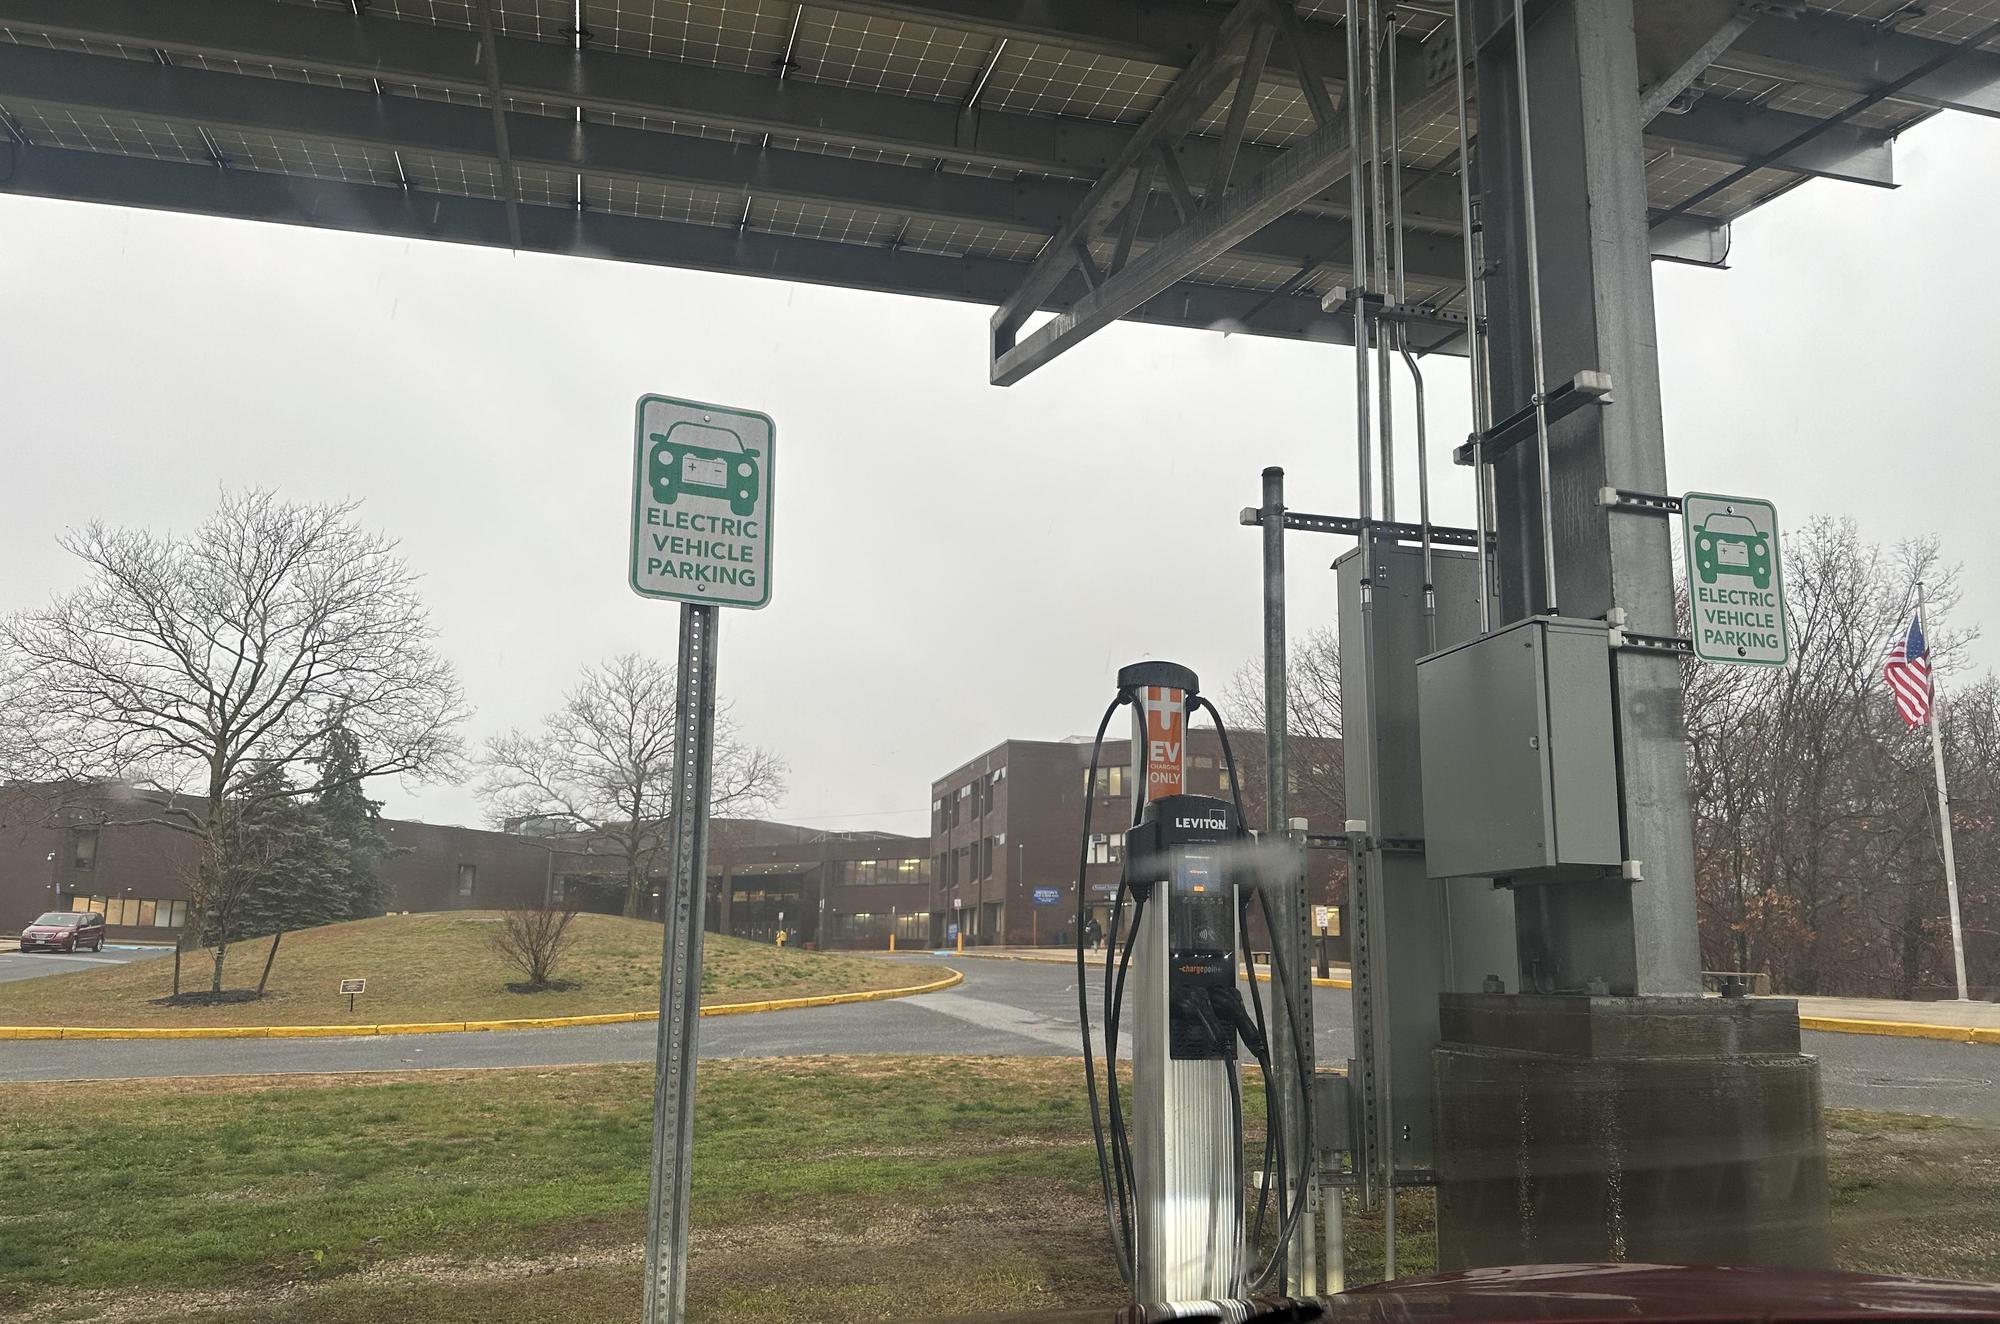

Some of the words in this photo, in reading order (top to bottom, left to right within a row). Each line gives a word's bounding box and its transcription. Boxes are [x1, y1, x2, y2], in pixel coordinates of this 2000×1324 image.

[647, 507, 759, 539] ELECTRIC
[652, 533, 754, 563] VEHICLE
[647, 557, 756, 587] PARKING
[1698, 587, 1776, 608] ELECTRIC
[1704, 608, 1775, 629] VEHICLE
[1704, 629, 1779, 649] PARKING
[1150, 740, 1181, 763] EV
[1150, 763, 1181, 771] CHARGING
[1150, 771, 1181, 785] ONLY
[1175, 817, 1227, 830] LEVITON
